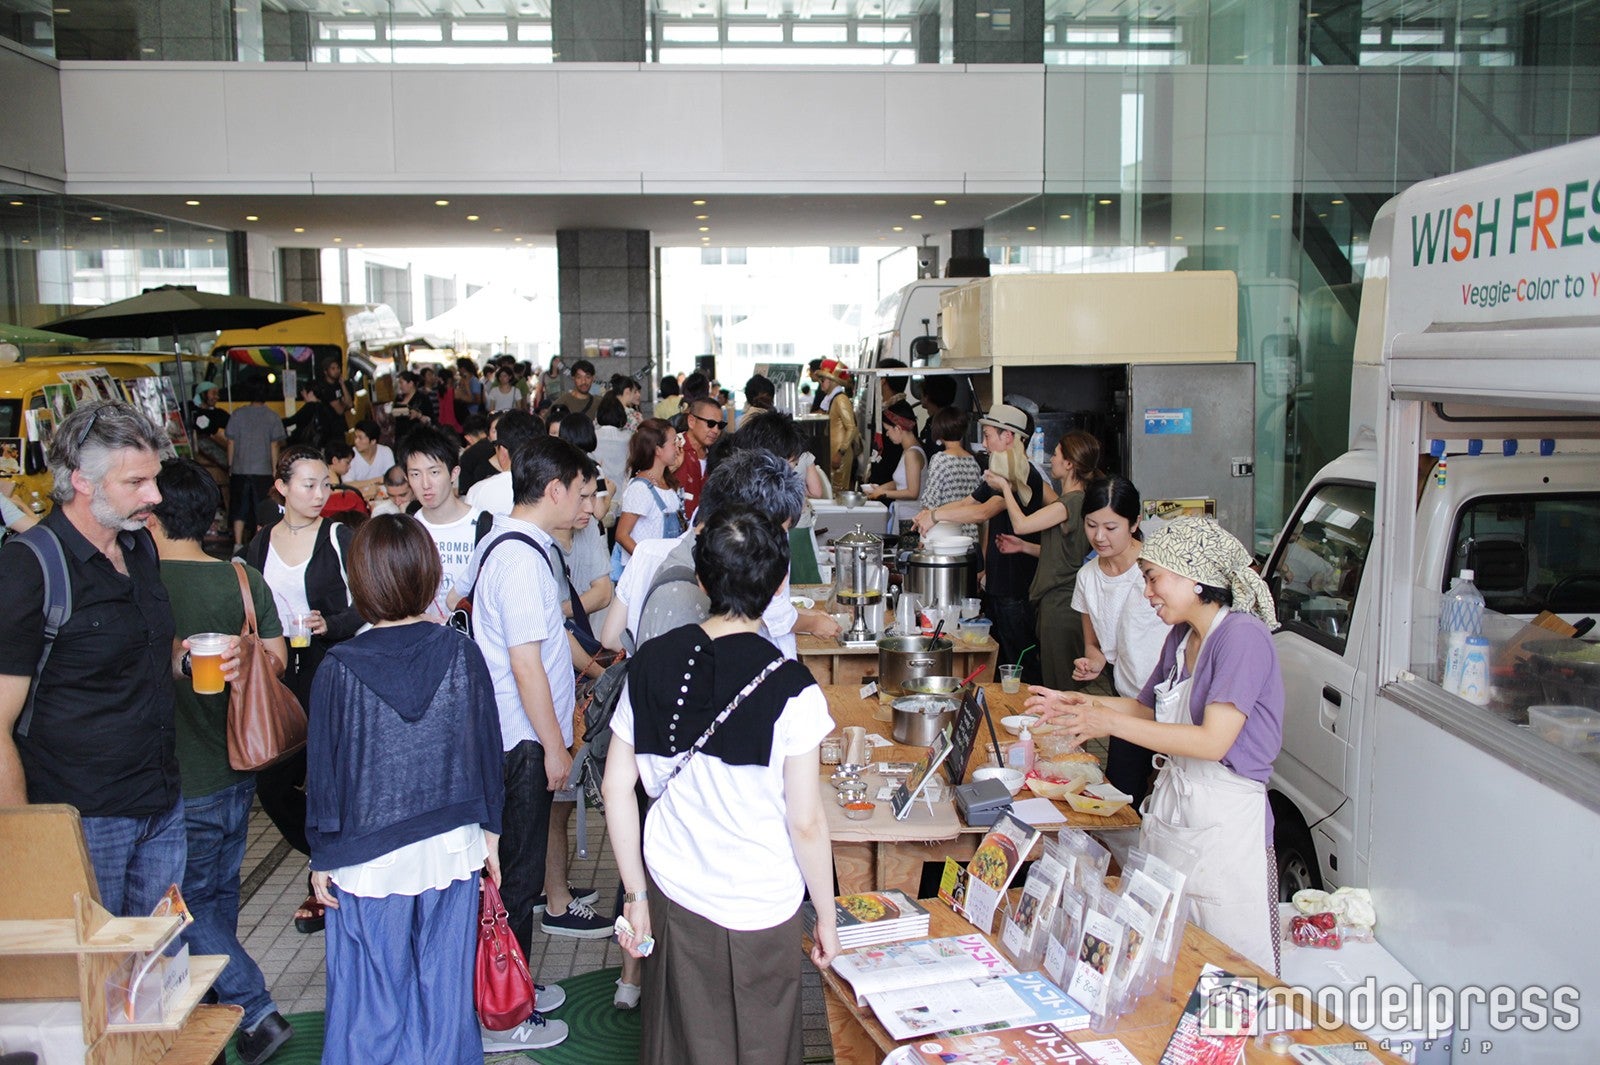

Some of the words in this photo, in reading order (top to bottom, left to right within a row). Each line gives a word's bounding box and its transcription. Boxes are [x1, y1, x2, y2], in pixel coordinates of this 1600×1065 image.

[1411, 197, 1501, 267] WISH
[1462, 276, 1560, 308] Veggie-Color
[1565, 274, 1586, 299] to
[436, 541, 474, 553] ROMBI
[456, 554, 470, 565] NY
[956, 936, 1000, 968] ソトコト
[1013, 974, 1066, 1009] ソトコト
[511, 1026, 533, 1043] N
